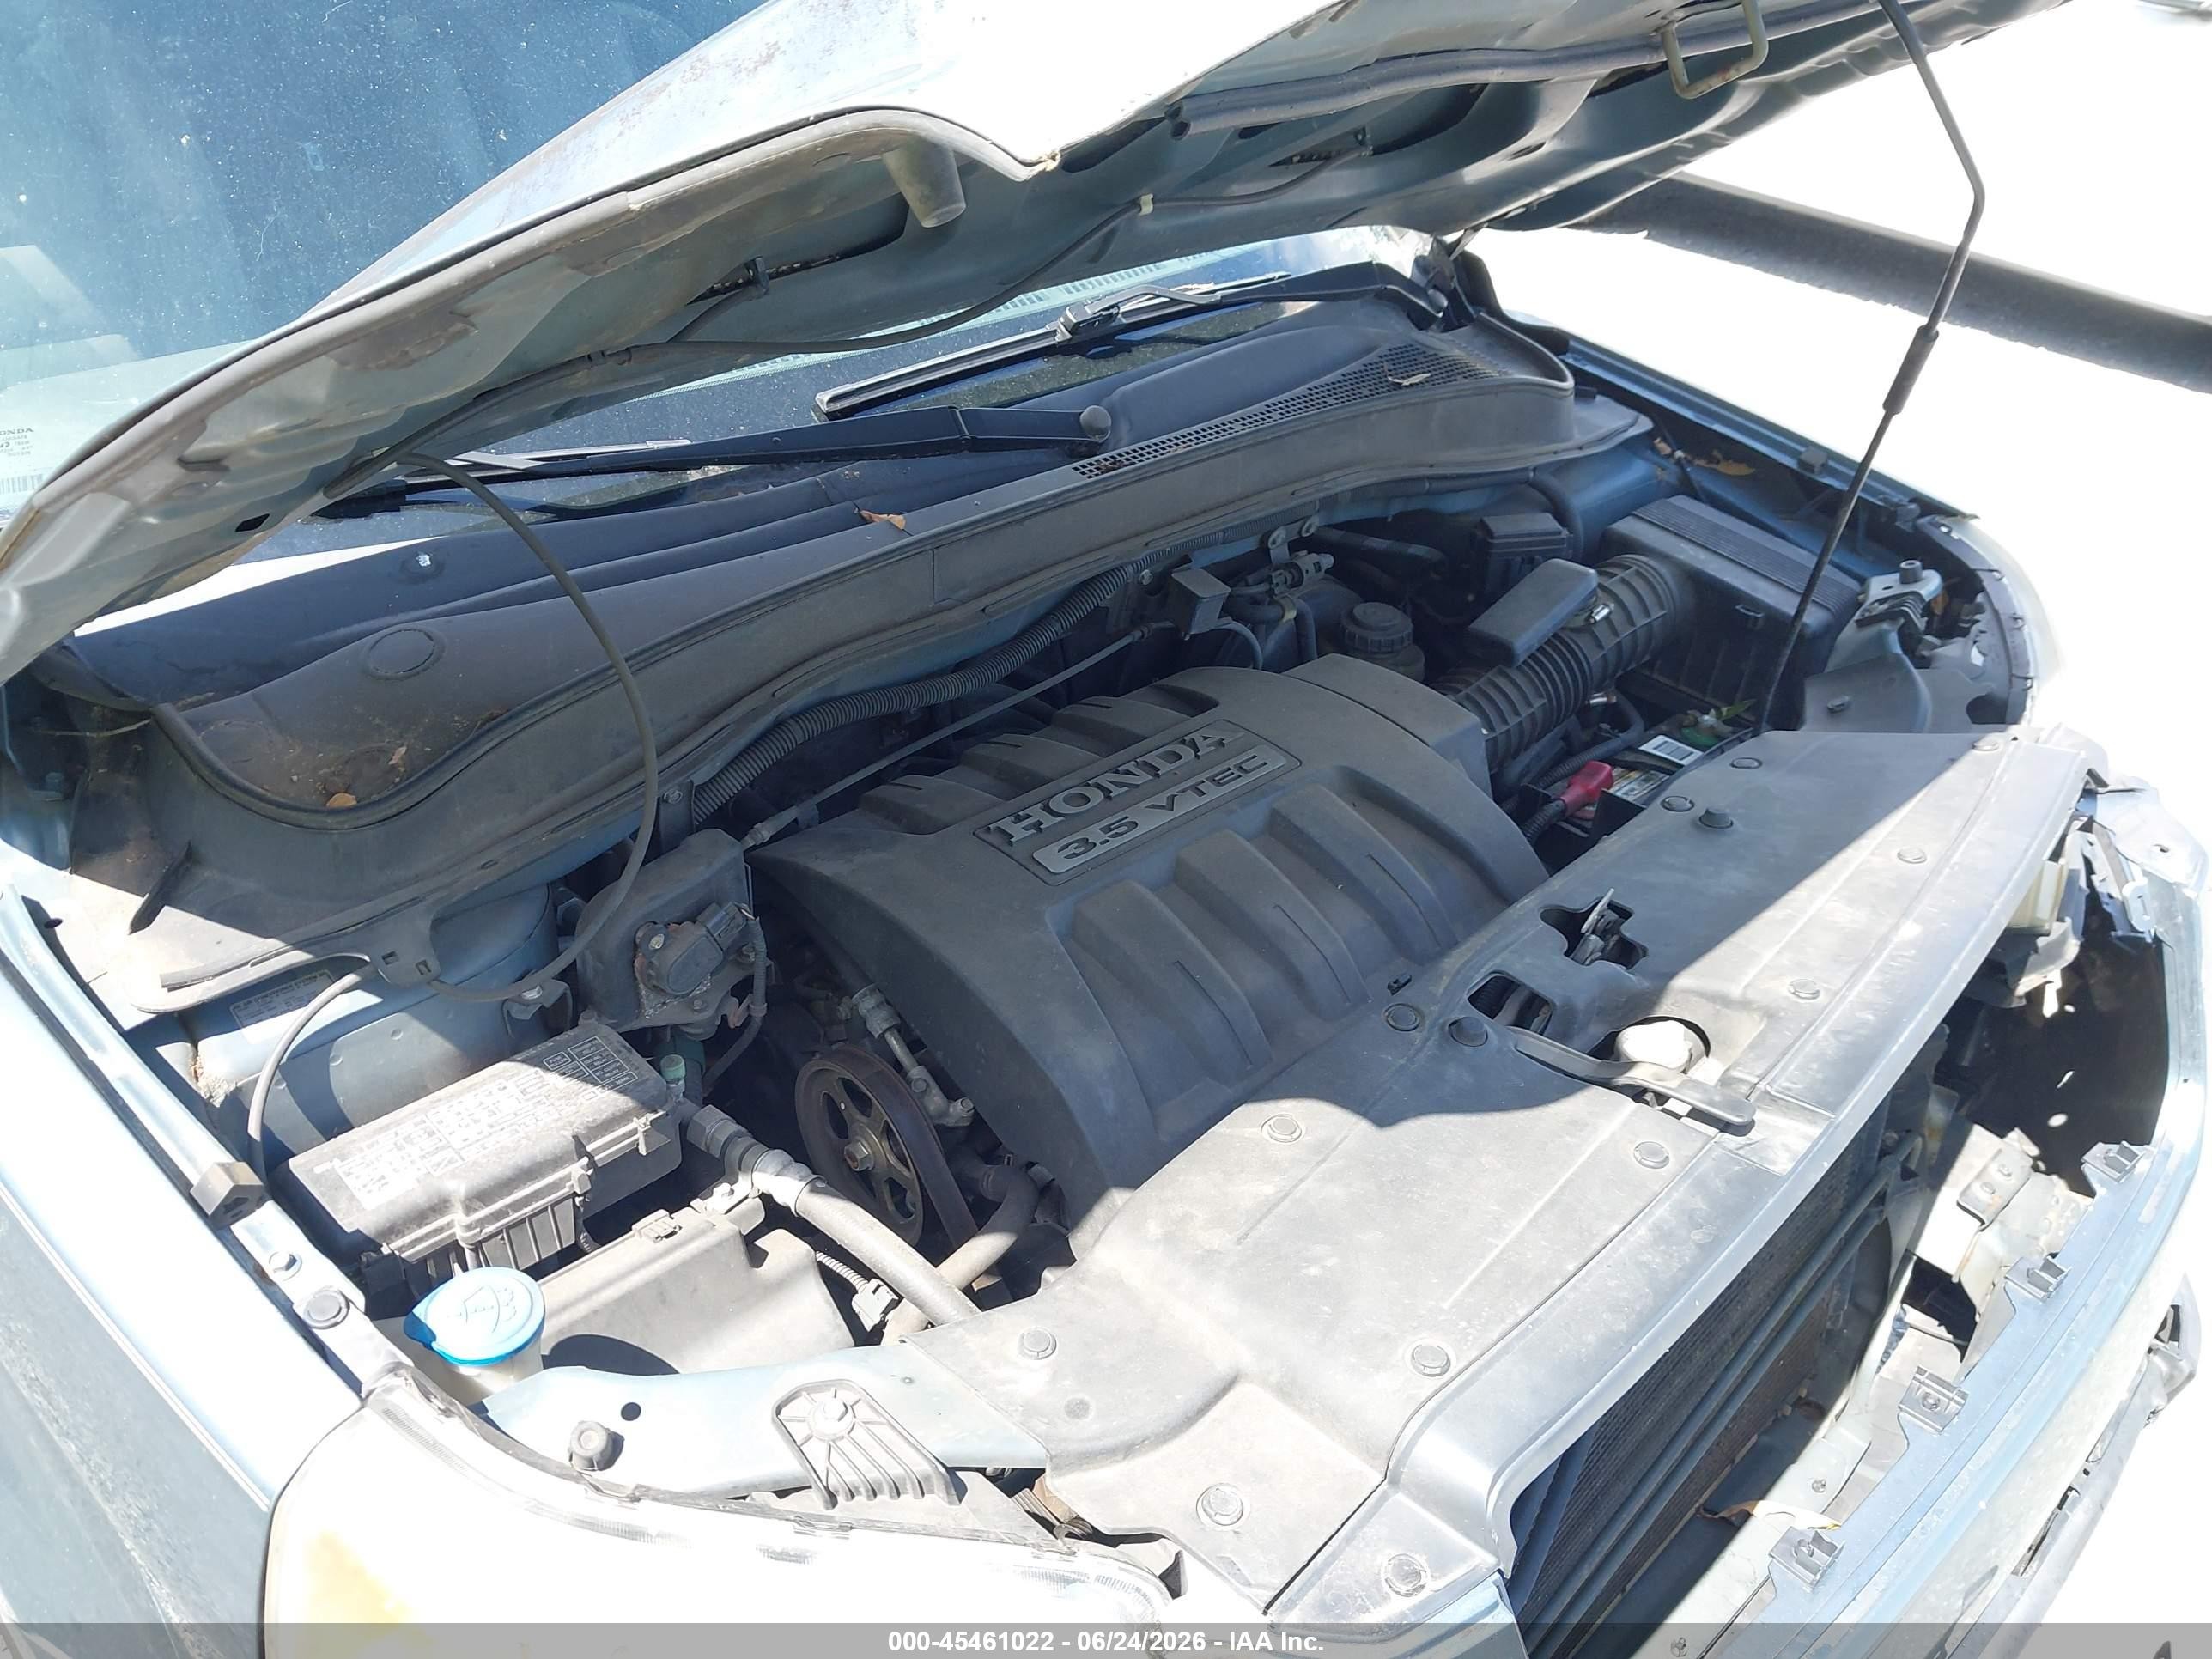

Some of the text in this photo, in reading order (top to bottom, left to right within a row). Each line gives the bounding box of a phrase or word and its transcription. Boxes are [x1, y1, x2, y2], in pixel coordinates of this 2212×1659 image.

[988, 730, 1244, 845] HONDA
[1057, 754, 1268, 860] 3.5 VTEC
